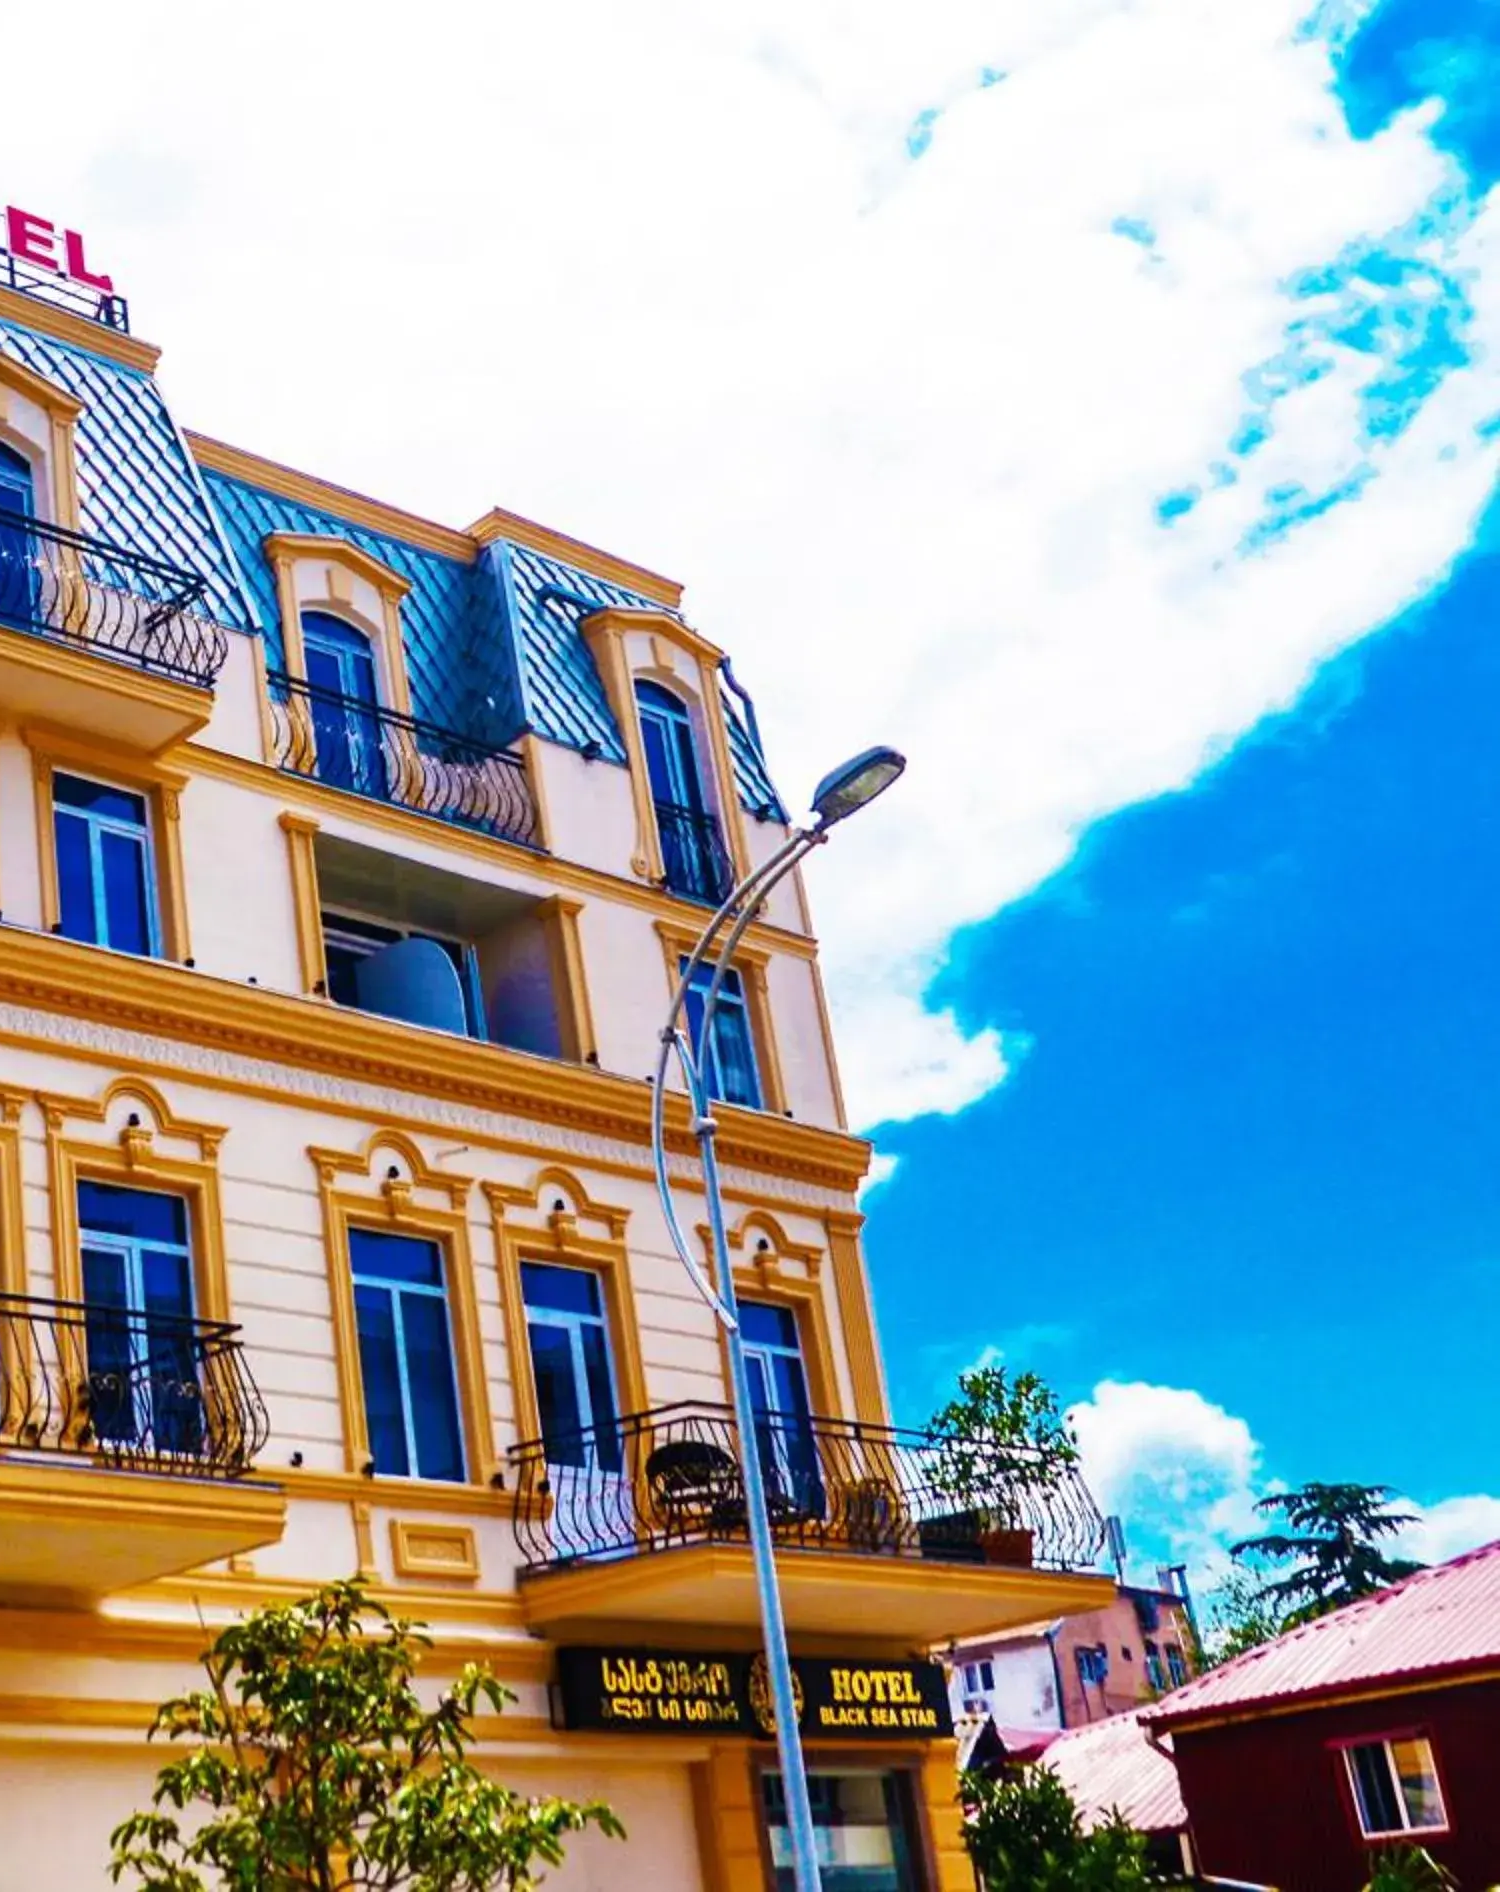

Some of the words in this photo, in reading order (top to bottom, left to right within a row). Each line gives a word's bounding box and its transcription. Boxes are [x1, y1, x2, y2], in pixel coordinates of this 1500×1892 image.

[601, 1657, 731, 1696] სასტუმრო
[830, 1668, 922, 1703] HOTEL
[820, 1706, 869, 1727] BLACK
[871, 1707, 899, 1727] SEA
[902, 1708, 937, 1729] STAR
